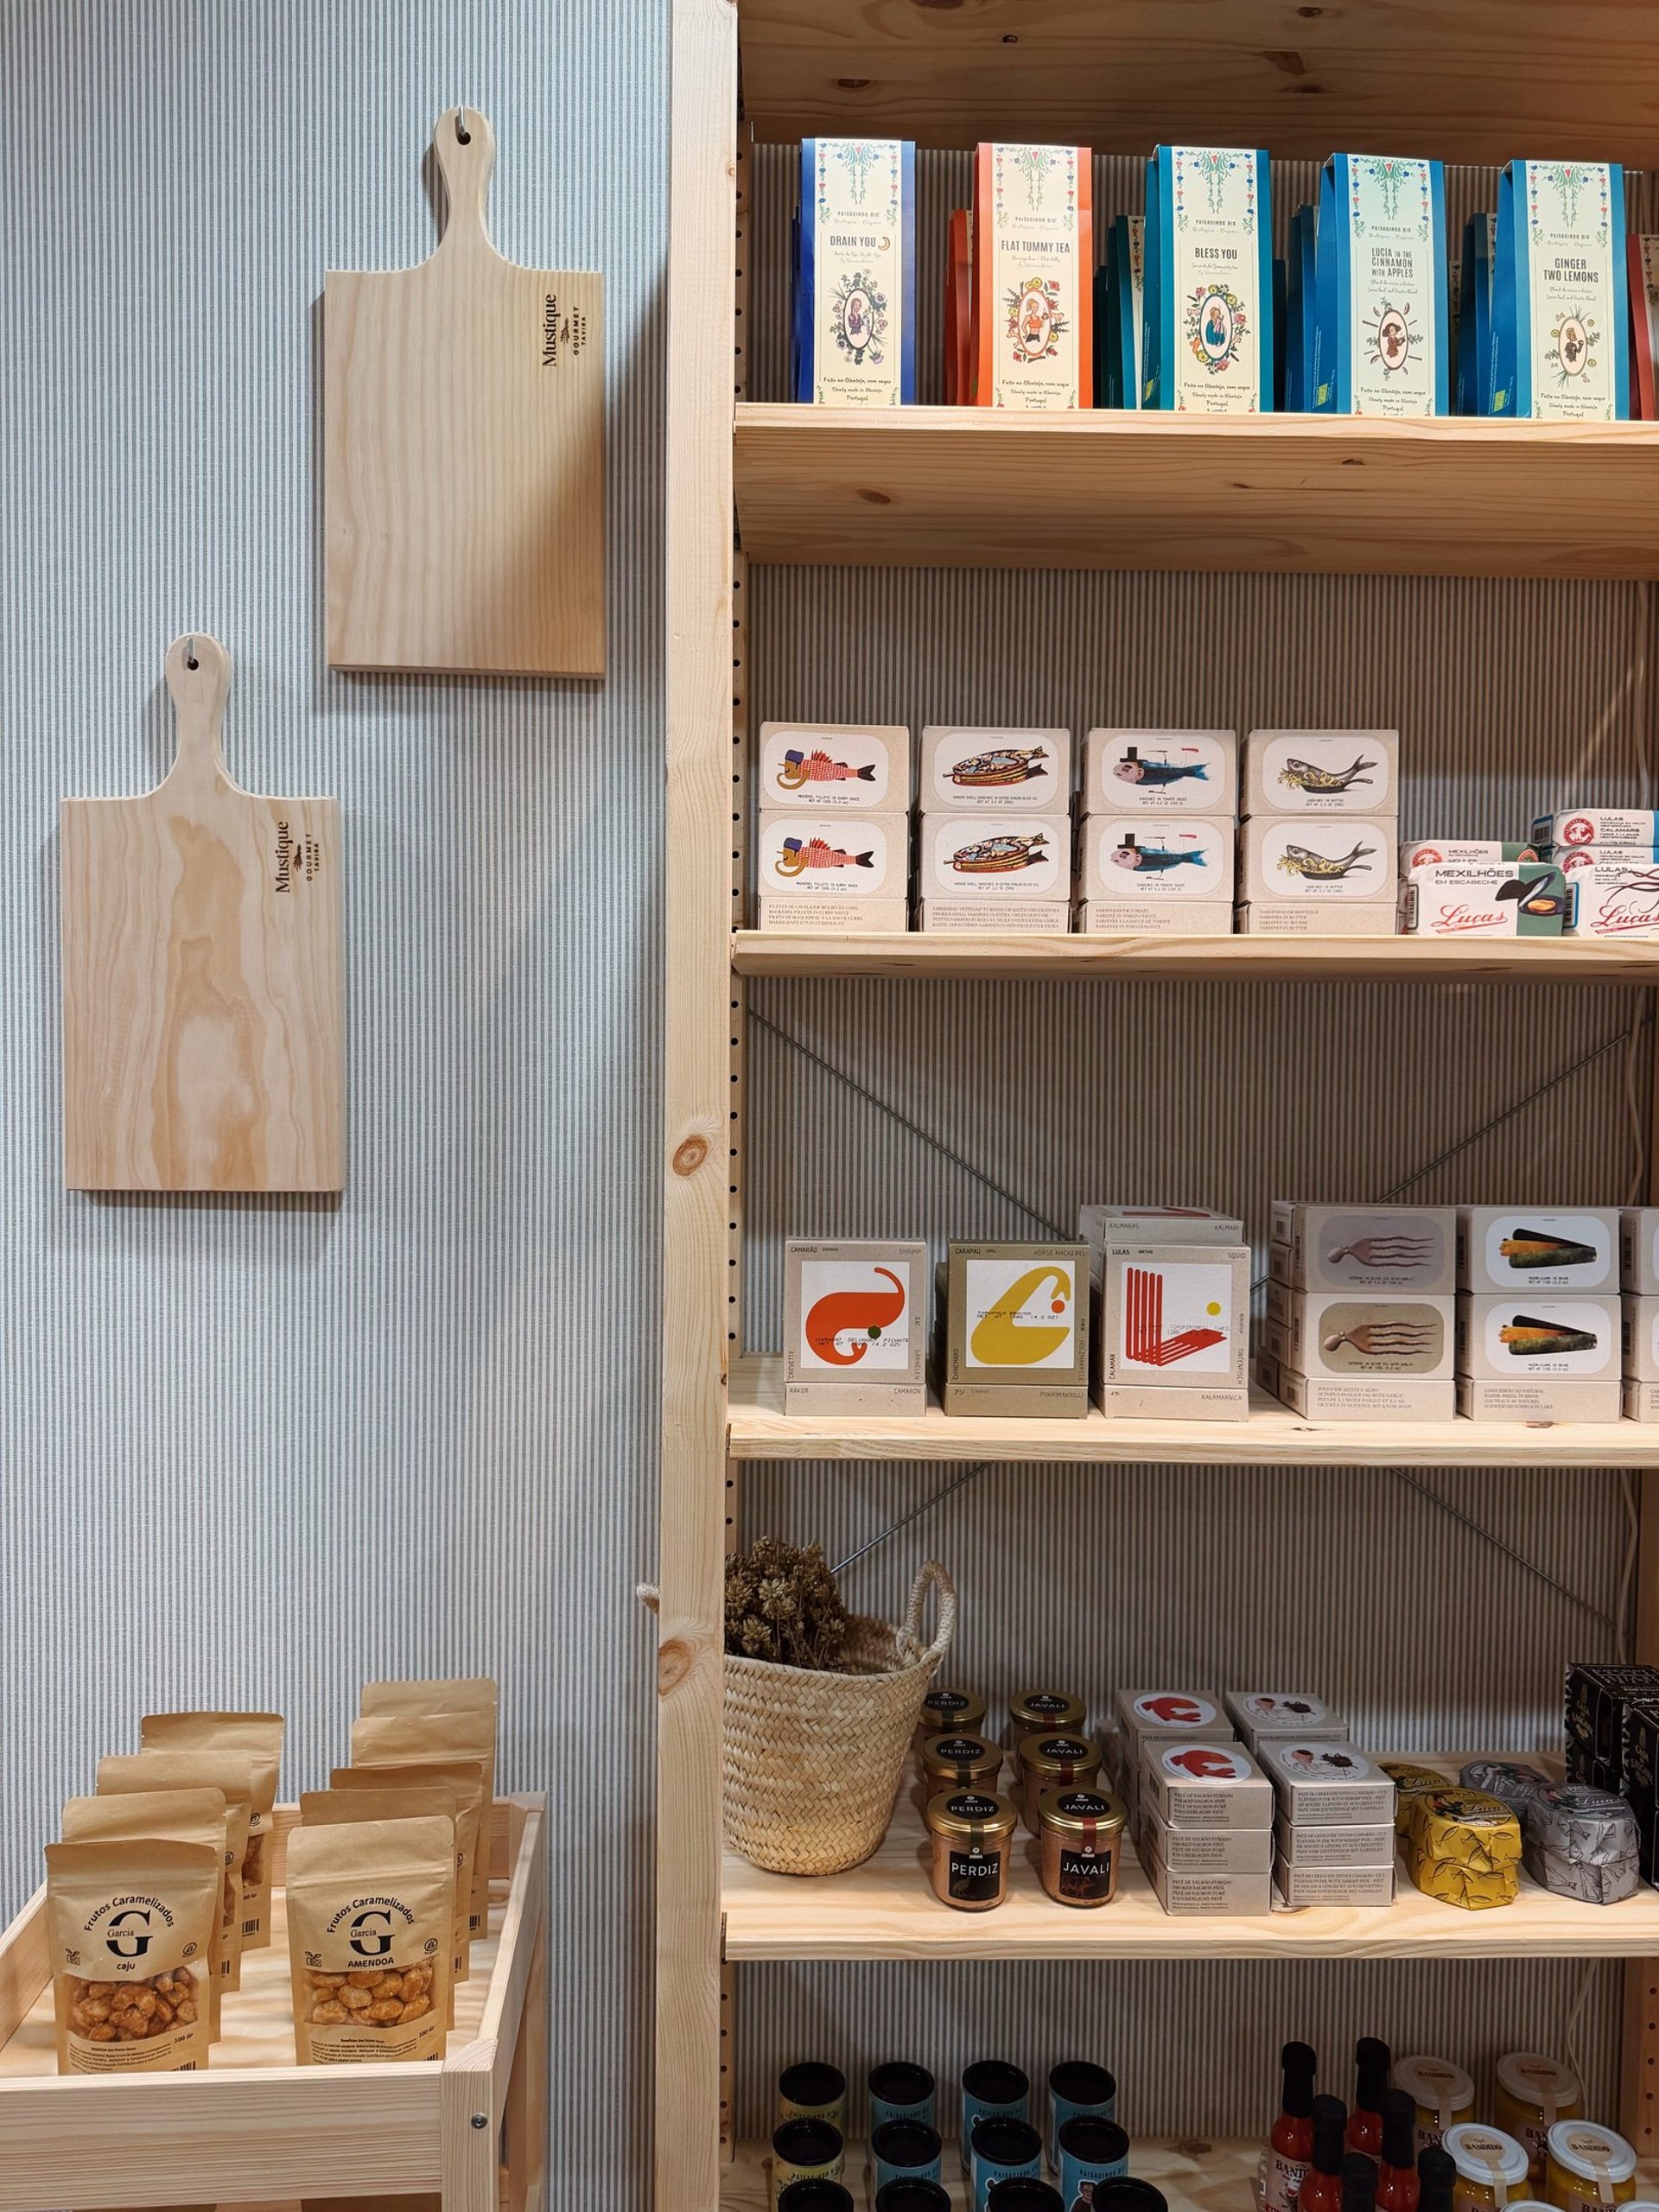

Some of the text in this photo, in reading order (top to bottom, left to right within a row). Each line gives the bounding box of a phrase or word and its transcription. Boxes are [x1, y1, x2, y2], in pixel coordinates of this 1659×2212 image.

[830, 235, 876, 247] DRAIN YOU
[1001, 240, 1071, 253] FLAT TUMMY TEA
[1194, 247, 1237, 260] BLESS YOU
[1371, 247, 1393, 257] LUCIA
[1371, 257, 1413, 268] CINNAMON
[1554, 257, 1586, 270] GINGER
[1371, 268, 1414, 278] WITH APPLES
[1543, 270, 1599, 283] TWO LEMONS
[542, 294, 561, 366] Mustique
[846, 394, 868, 403] Portugal
[275, 821, 294, 893] Mustique
[1434, 868, 1514, 878] MEXILHÕES
[951, 1861, 998, 1877] PERDIZ
[1063, 1861, 1109, 1876] JAVALI
[84, 1895, 175, 1932] Frutos Caramelizados
[327, 1897, 415, 1934] Frutos Caramelizados
[107, 1929, 135, 1937] Garcia
[351, 1929, 378, 1939] Garcia
[117, 1961, 136, 1972] caju
[347, 1957, 395, 1968] AMENDOA
[418, 2030, 429, 2038] 100
[1465, 2143, 1503, 2152] BANDIDO
[1571, 2143, 1611, 2152] BANDIDO
